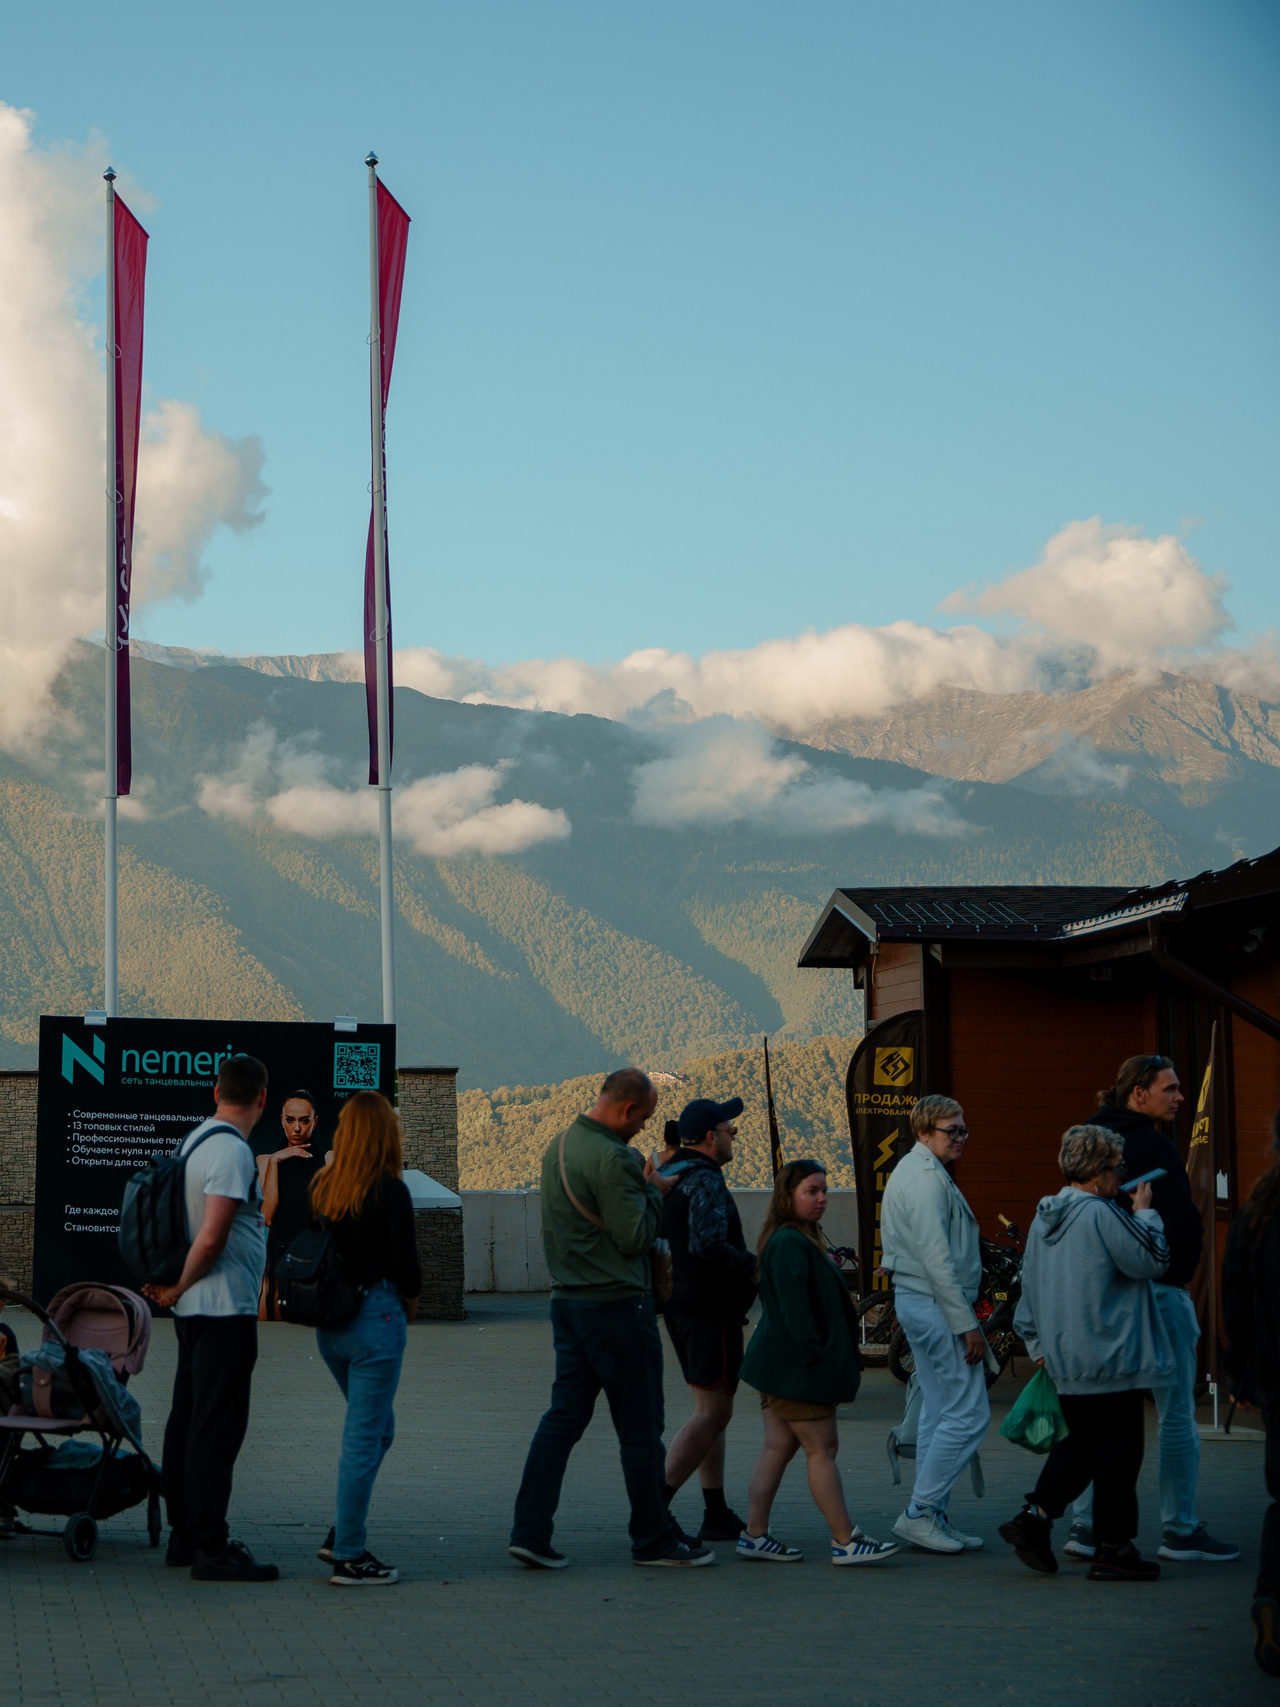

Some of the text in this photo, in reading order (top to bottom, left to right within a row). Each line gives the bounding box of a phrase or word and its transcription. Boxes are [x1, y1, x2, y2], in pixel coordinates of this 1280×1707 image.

[121, 1044, 248, 1076] nemeri
[121, 1077, 143, 1085] сеть
[145, 1078, 215, 1087] танцевальных
[854, 1093, 918, 1106] ПРОДАЖА
[73, 1109, 138, 1120] Современные
[140, 1112, 205, 1122] танцевальные
[855, 1107, 911, 1116] ЛЕКТРОБАЙК
[73, 1121, 156, 1132] 13 топовых стилей
[72, 1133, 164, 1145] Профессиональные
[72, 1144, 113, 1155] Обучаем
[121, 1148, 141, 1156] нуля
[72, 1156, 113, 1167] Открыты
[114, 1160, 132, 1168] для
[64, 1204, 120, 1216] Где каждое
[64, 1221, 120, 1233] Становится
